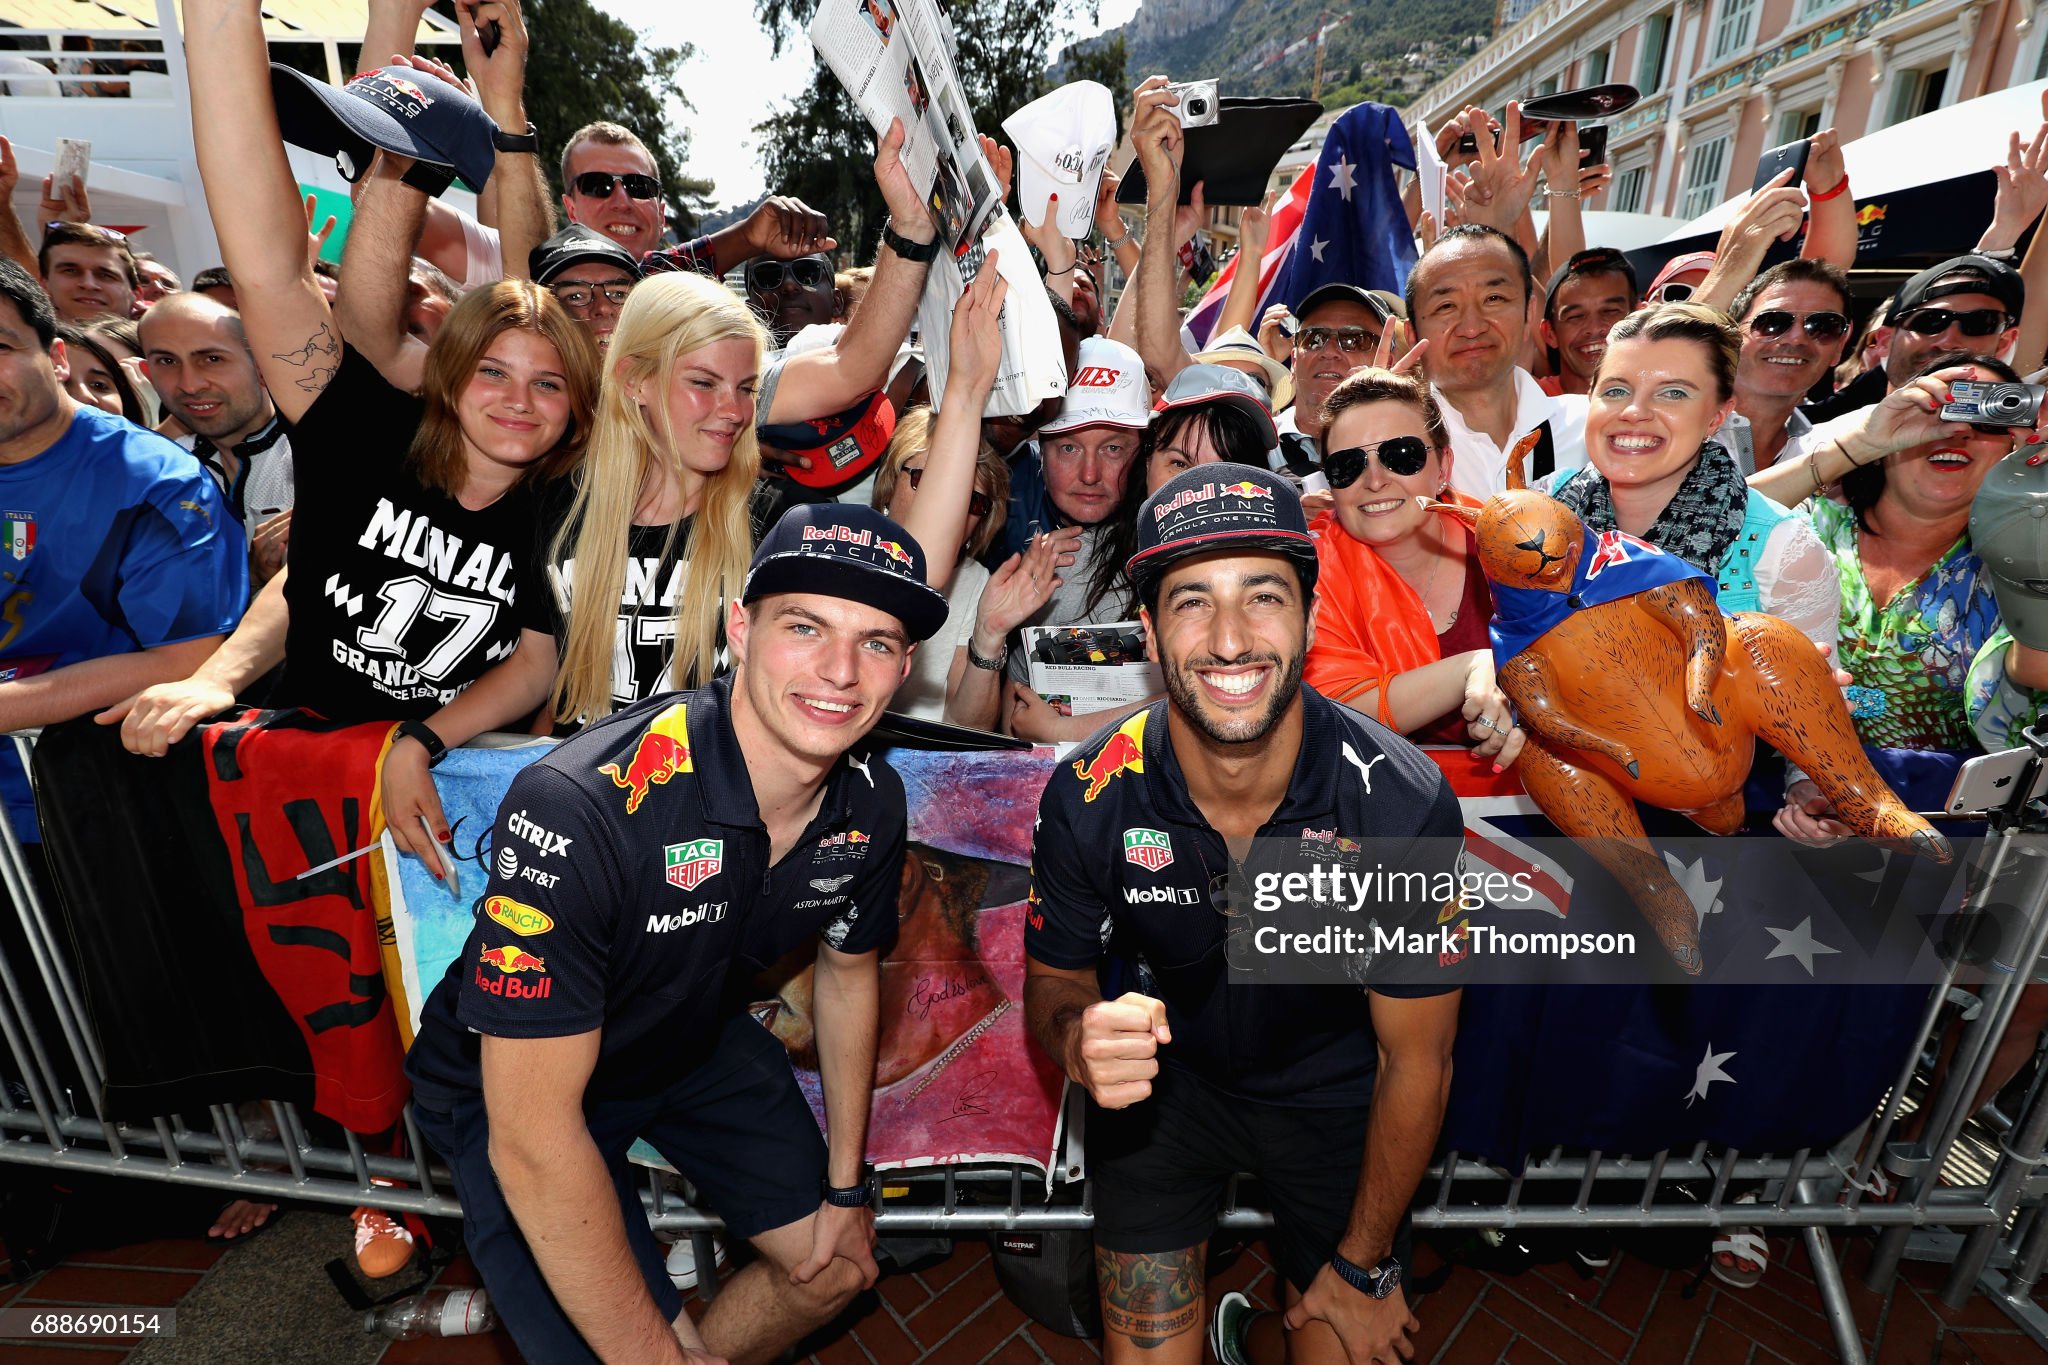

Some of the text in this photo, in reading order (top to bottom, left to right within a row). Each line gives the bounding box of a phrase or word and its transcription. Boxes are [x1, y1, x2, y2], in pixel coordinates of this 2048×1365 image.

[1154, 482, 1216, 523] Red Bull
[4, 512, 33, 520] ITALIA
[1157, 499, 1276, 535] RACING
[1213, 515, 1239, 523] ONE
[1246, 515, 1277, 526] TEAM
[803, 524, 872, 547] Red Bull
[356, 574, 500, 682] 17
[333, 638, 420, 688] GRAND
[372, 679, 410, 701] SINCE
[1126, 831, 1167, 847] TAG
[1302, 828, 1325, 843] Red
[670, 842, 717, 863] TAG
[1128, 847, 1171, 868] HEUER
[520, 866, 561, 889] AT&T
[668, 861, 718, 887] HEUER
[793, 900, 821, 910] ASTON
[1122, 886, 1176, 904] Mobil
[501, 904, 543, 929] RAUCH
[646, 903, 708, 933] Mobil
[475, 965, 552, 999] Red Bull
[1003, 1241, 1034, 1249] EASTPAK
[1135, 1308, 1194, 1333] MEMORIES
